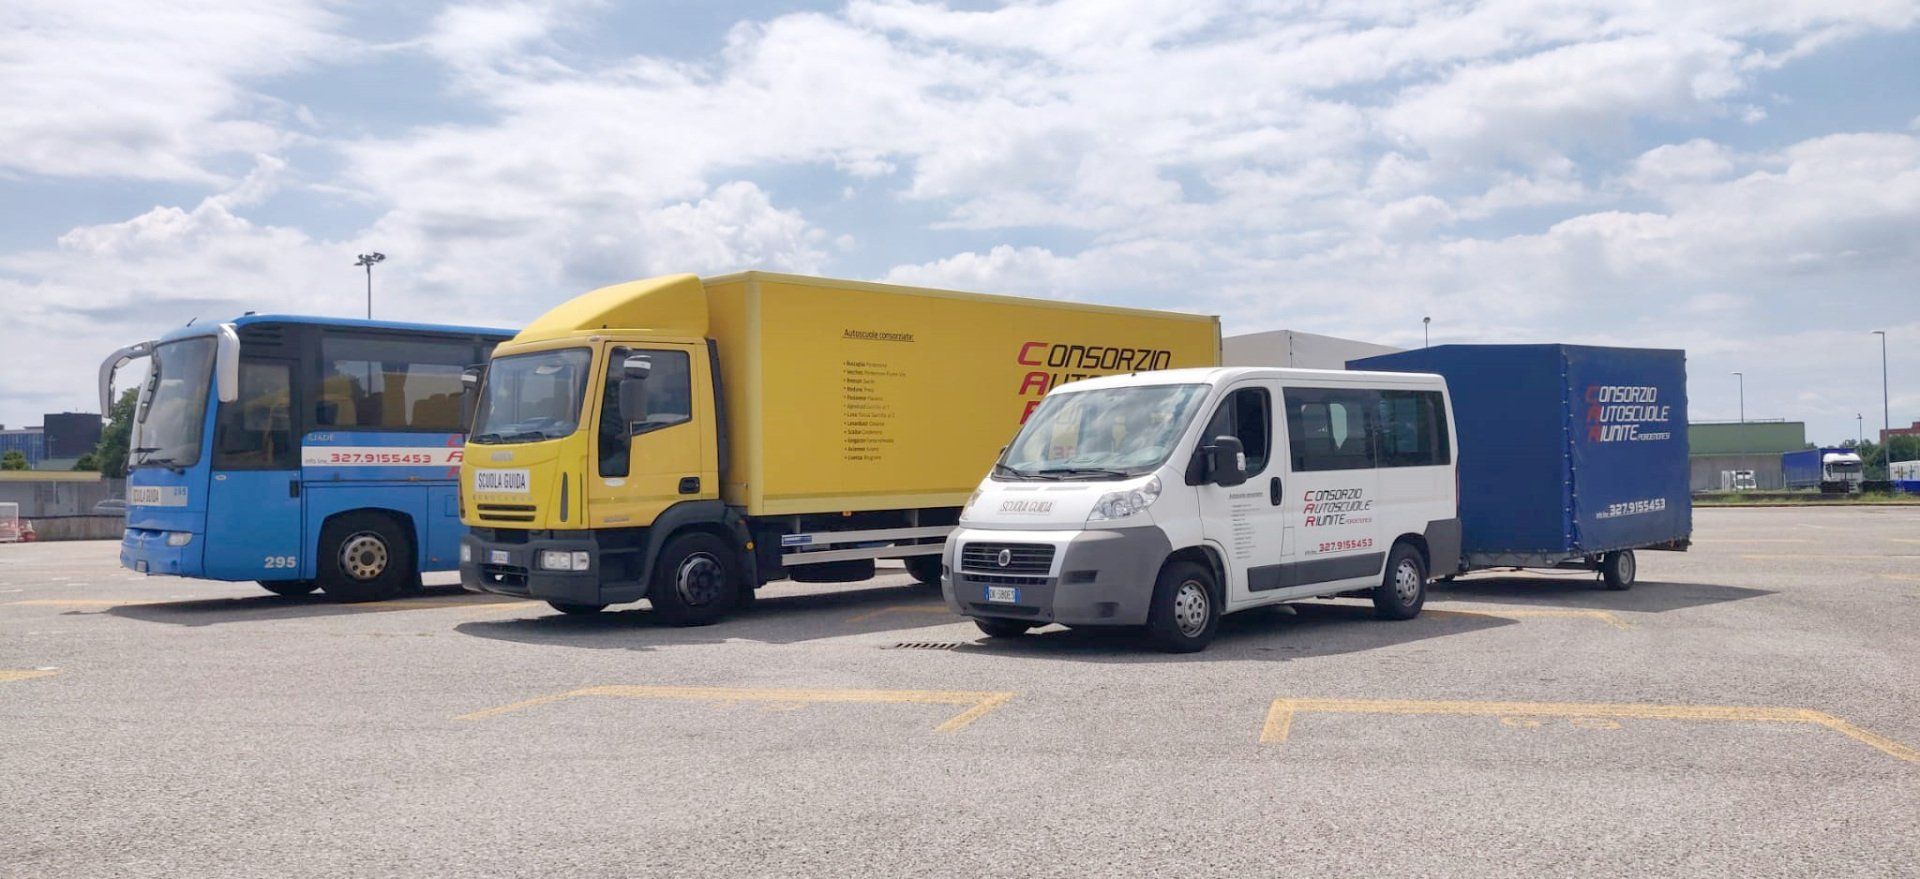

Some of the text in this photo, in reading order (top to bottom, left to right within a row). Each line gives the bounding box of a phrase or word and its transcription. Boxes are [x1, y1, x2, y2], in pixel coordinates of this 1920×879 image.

[1017, 341, 1171, 371] CONSORZIO
[1584, 385, 1657, 403] CONSORZIO
[1587, 405, 1670, 422] AUTOSCUOLE
[1588, 424, 1639, 443] RIUNITE
[331, 453, 432, 464] 327.9155453
[478, 473, 526, 489] SCUOLA GUIDA
[1304, 489, 1362, 502] CONSORZIO
[1303, 500, 1373, 514] AUTOSCUOLE
[1608, 498, 1665, 516] 327.9155453
[1305, 514, 1345, 527] RIUNITE
[1319, 539, 1373, 551] 327.9155453
[264, 556, 297, 568] 295
